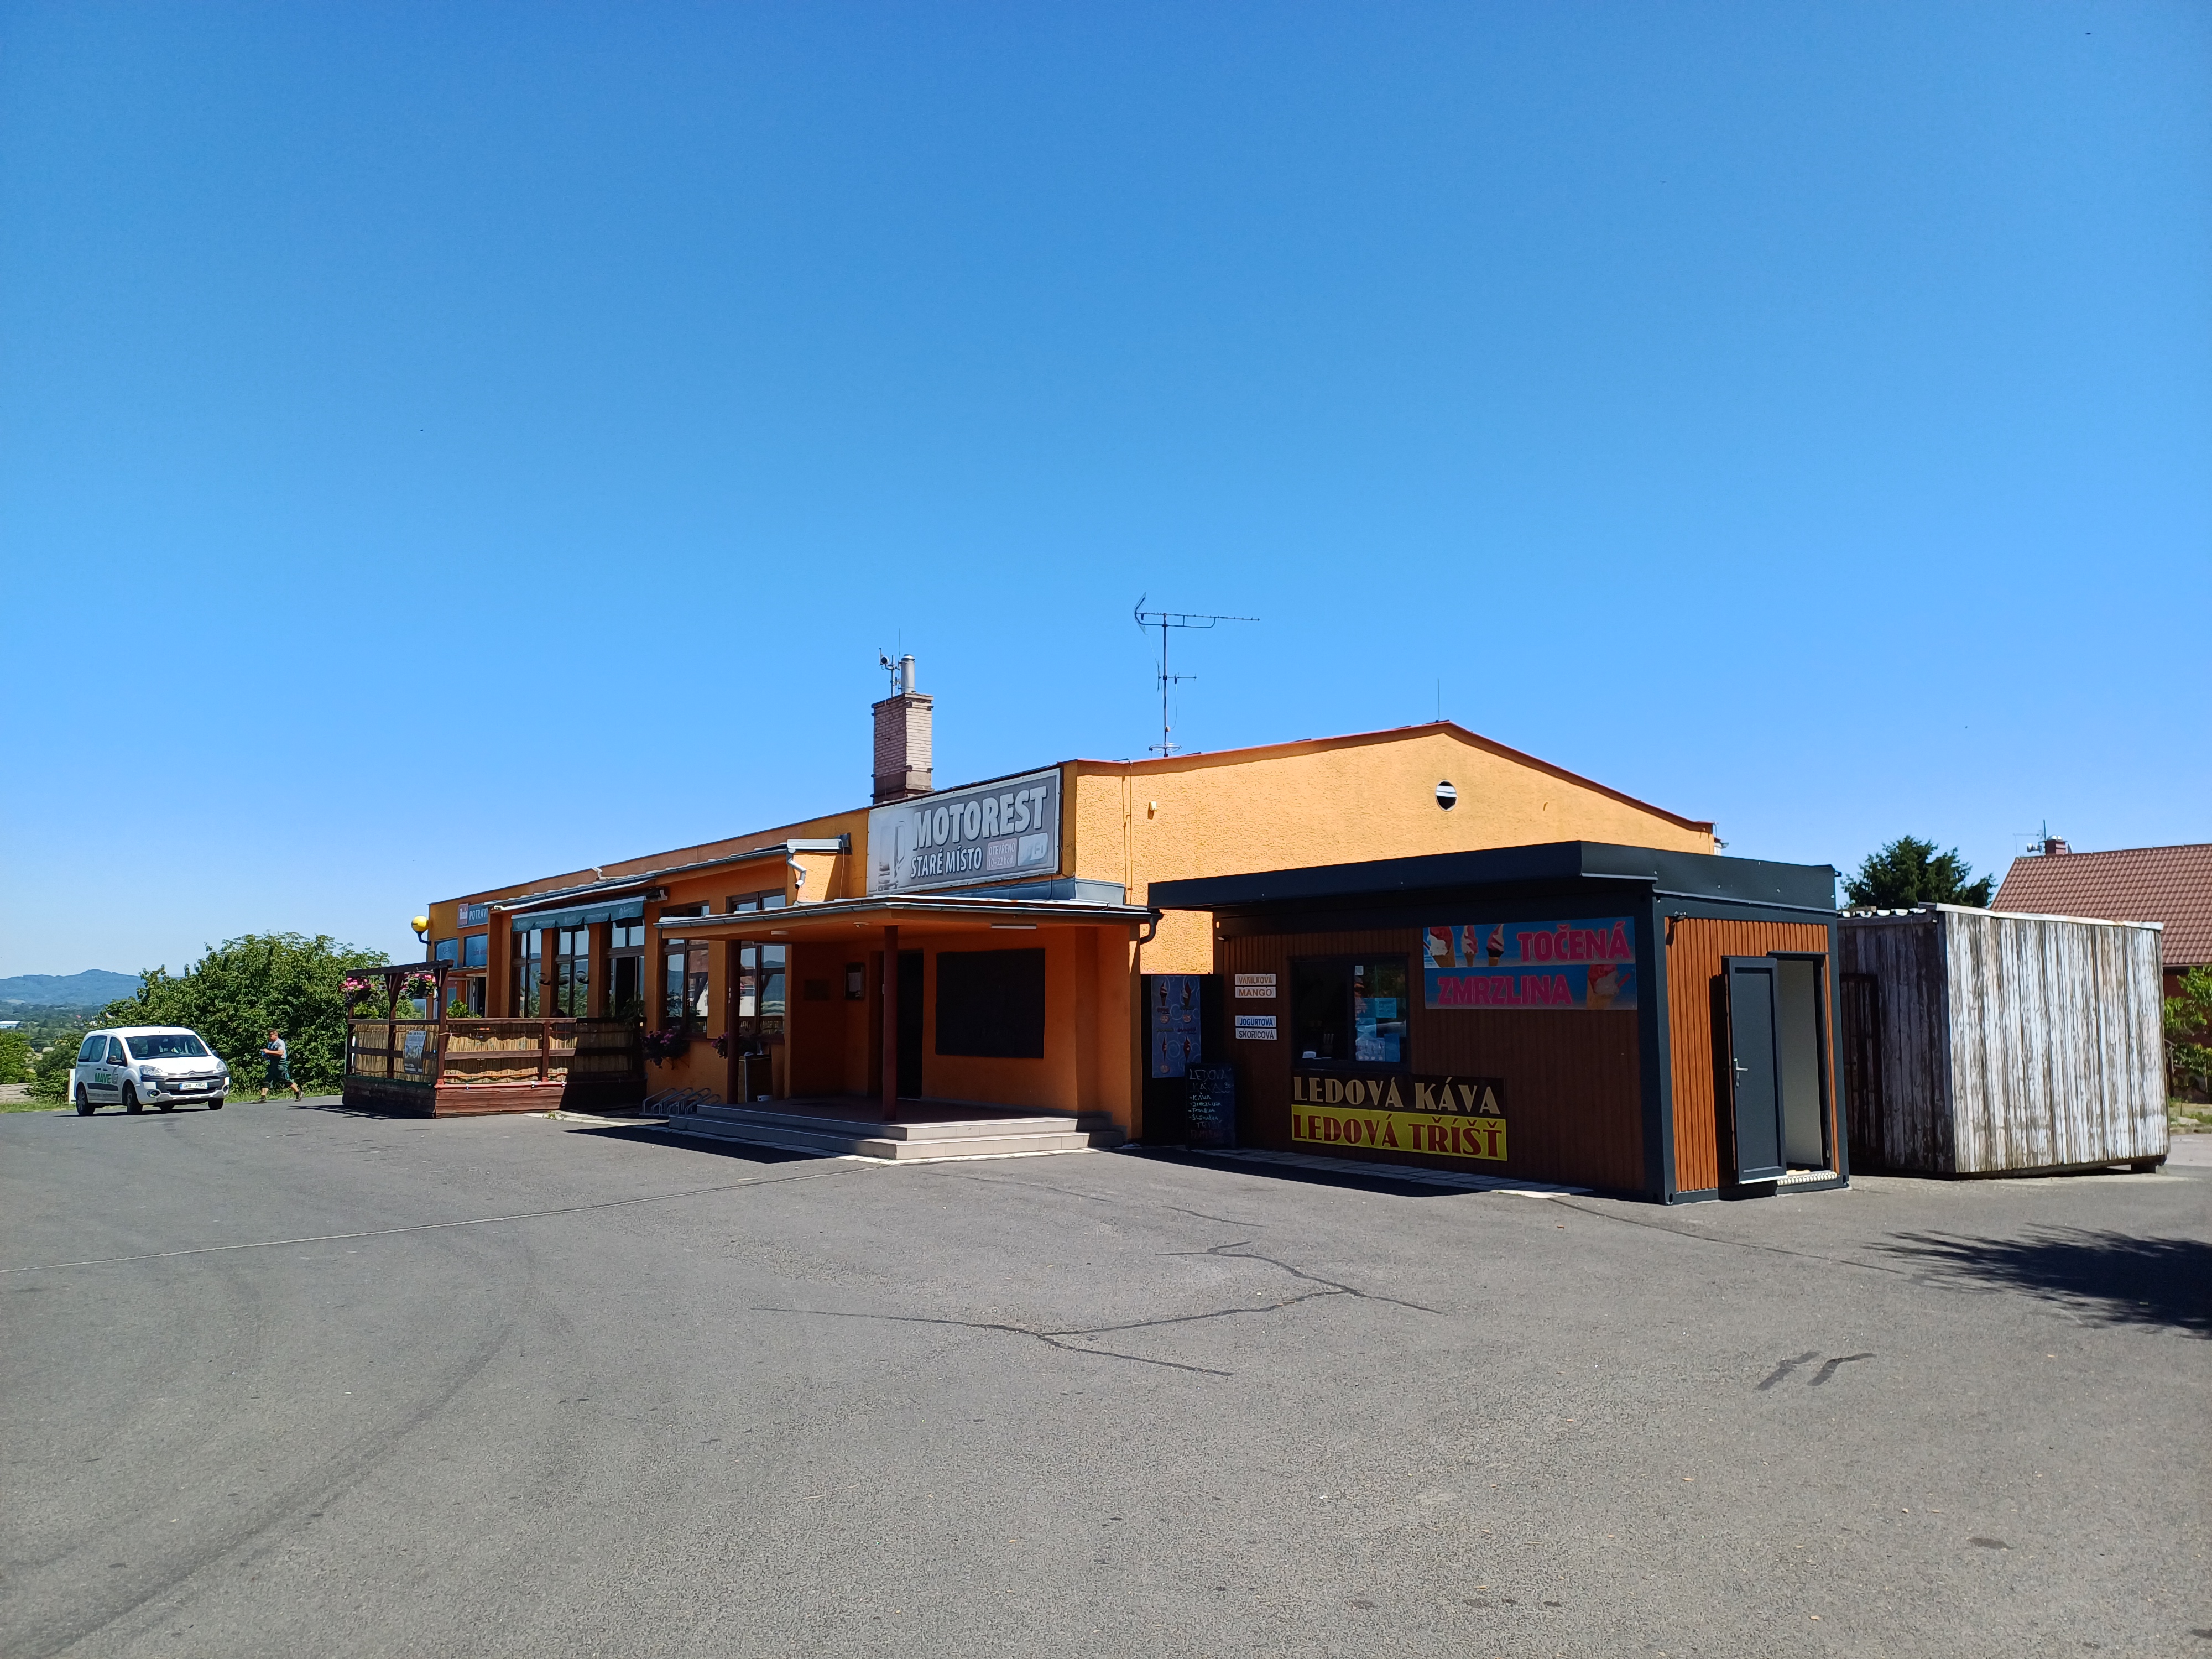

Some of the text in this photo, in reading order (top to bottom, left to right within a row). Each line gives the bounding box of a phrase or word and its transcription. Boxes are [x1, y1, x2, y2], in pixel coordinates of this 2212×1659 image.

[913, 786, 1047, 850] MOTOREST
[989, 842, 1015, 855] OTEVŘENO
[911, 846, 982, 878] STARÉ MÍSTO
[1003, 855, 1014, 864] hod.
[1516, 921, 1631, 962] TOČENÁ
[1239, 975, 1273, 984] VANILKOVÁ
[1437, 975, 1573, 1005] ZMRZLINA
[1239, 1018, 1274, 1026] JOGURTOVÁ
[1239, 1029, 1274, 1039] SKOŘICOVÁ
[95, 1073, 111, 1084] MAVE
[1293, 1076, 1501, 1115] LEDOVÁ KÁVA
[1292, 1114, 1503, 1157] LEDOVÁ TŘÍŠŤ
